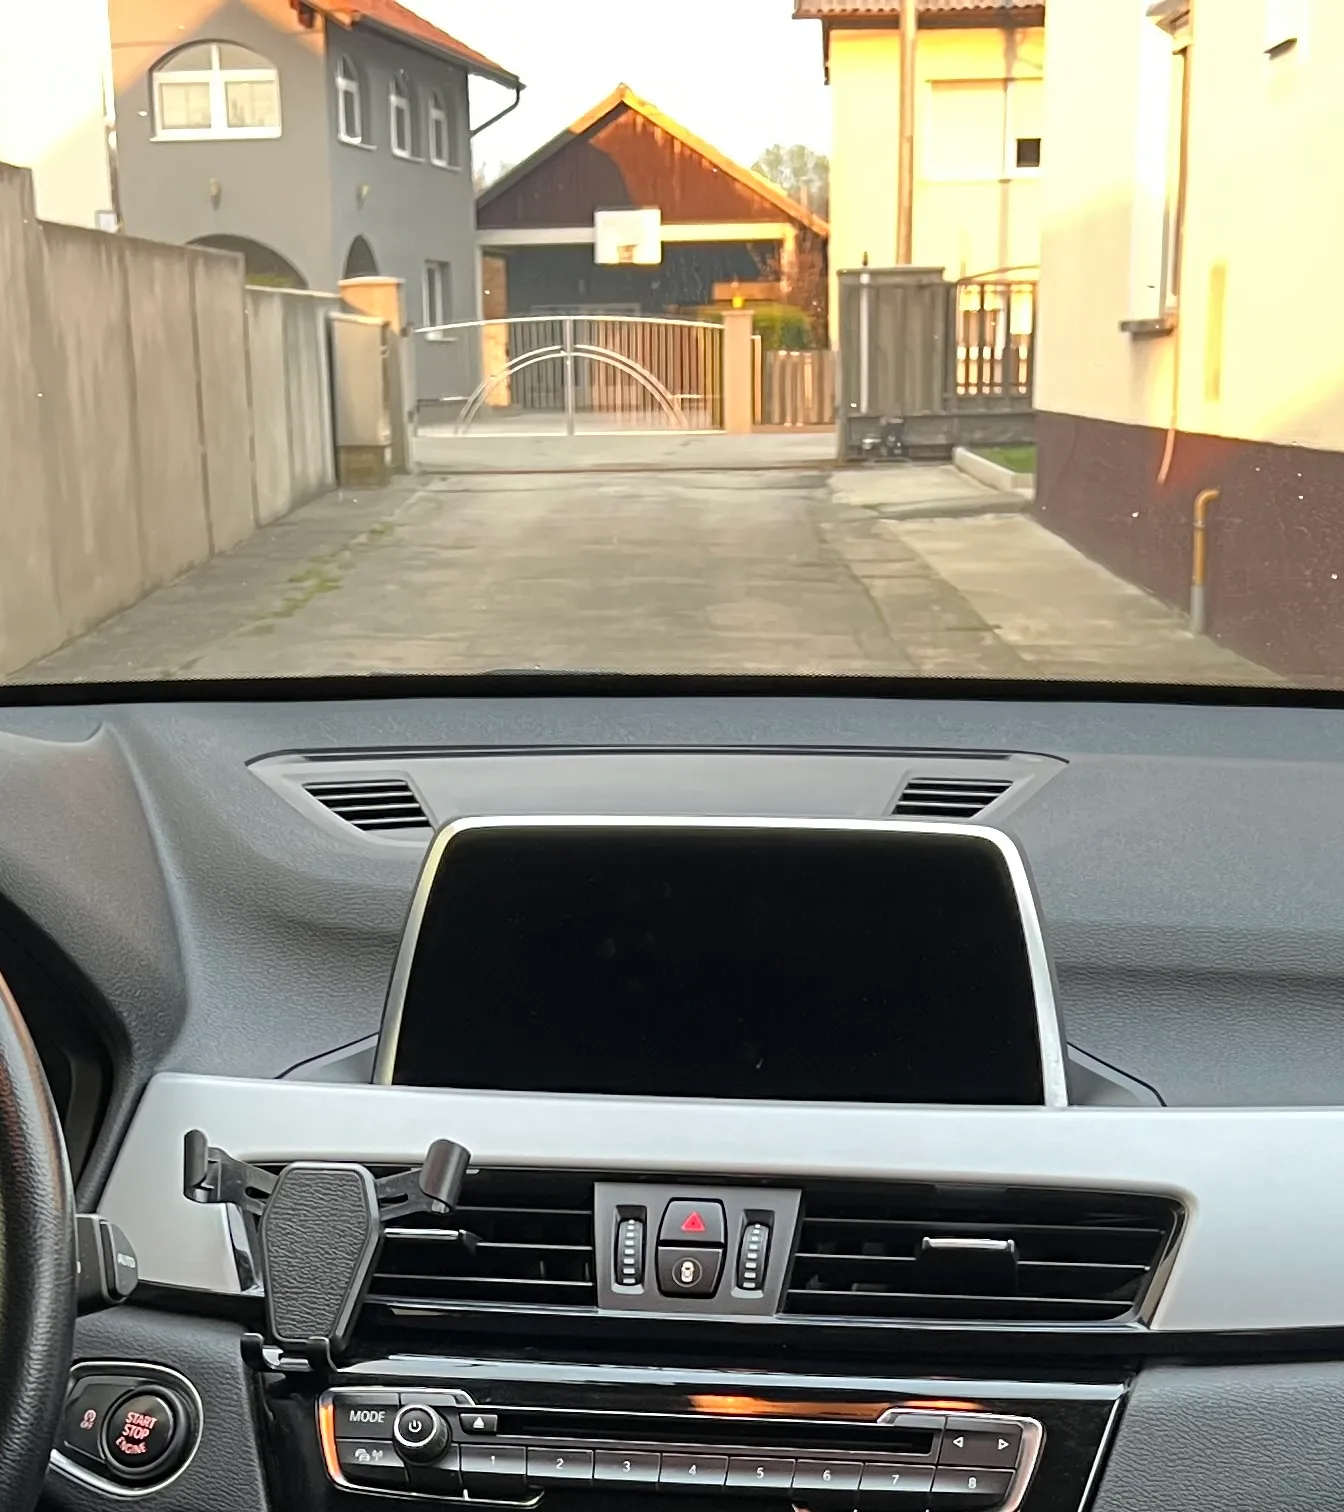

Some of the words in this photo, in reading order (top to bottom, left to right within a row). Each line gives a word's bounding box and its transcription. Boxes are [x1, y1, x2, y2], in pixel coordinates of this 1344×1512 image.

[125, 1411, 158, 1429] START
[349, 1410, 386, 1423] MODE
[122, 1423, 150, 1440] STOP
[556, 1458, 564, 1470] 2
[622, 1460, 631, 1472] 3
[688, 1464, 697, 1475] 4
[756, 1467, 765, 1479] 5
[822, 1469, 831, 1481] 6
[892, 1474, 900, 1485] 7
[968, 1477, 977, 1488] 8
